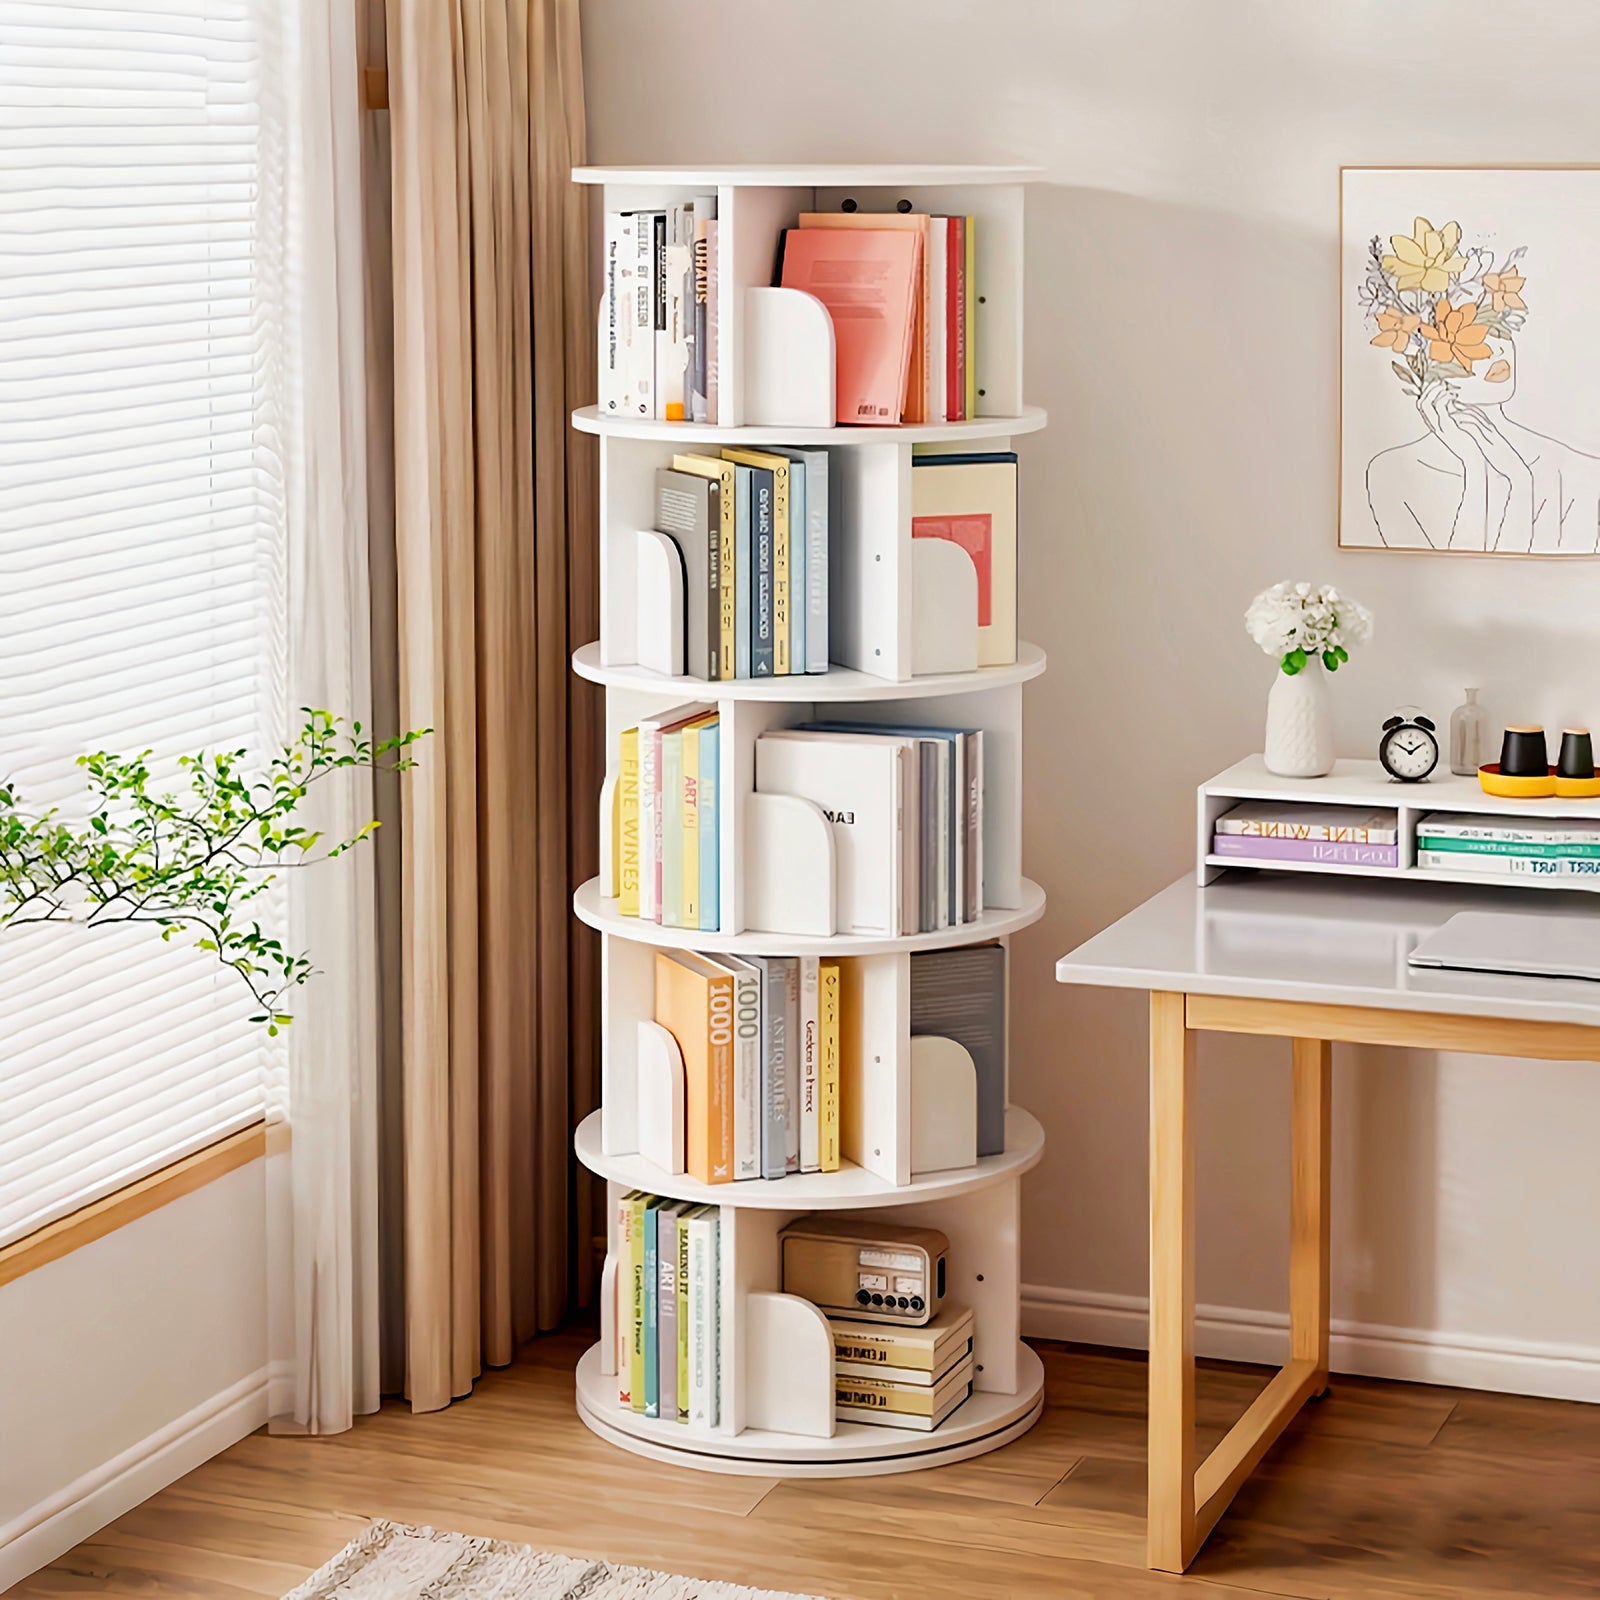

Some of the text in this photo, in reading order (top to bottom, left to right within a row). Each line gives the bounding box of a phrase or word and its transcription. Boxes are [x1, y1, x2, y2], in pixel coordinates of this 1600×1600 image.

[638, 265, 649, 279] BY
[638, 286, 649, 327] DESIGN
[684, 776, 697, 808] ART
[624, 759, 639, 891] FINE WINES
[709, 984, 732, 1045] 1000
[738, 977, 758, 1039] 1000
[679, 1228, 688, 1280] MAKING
[660, 1261, 675, 1294] ART
[680, 1281, 688, 1296] IT
